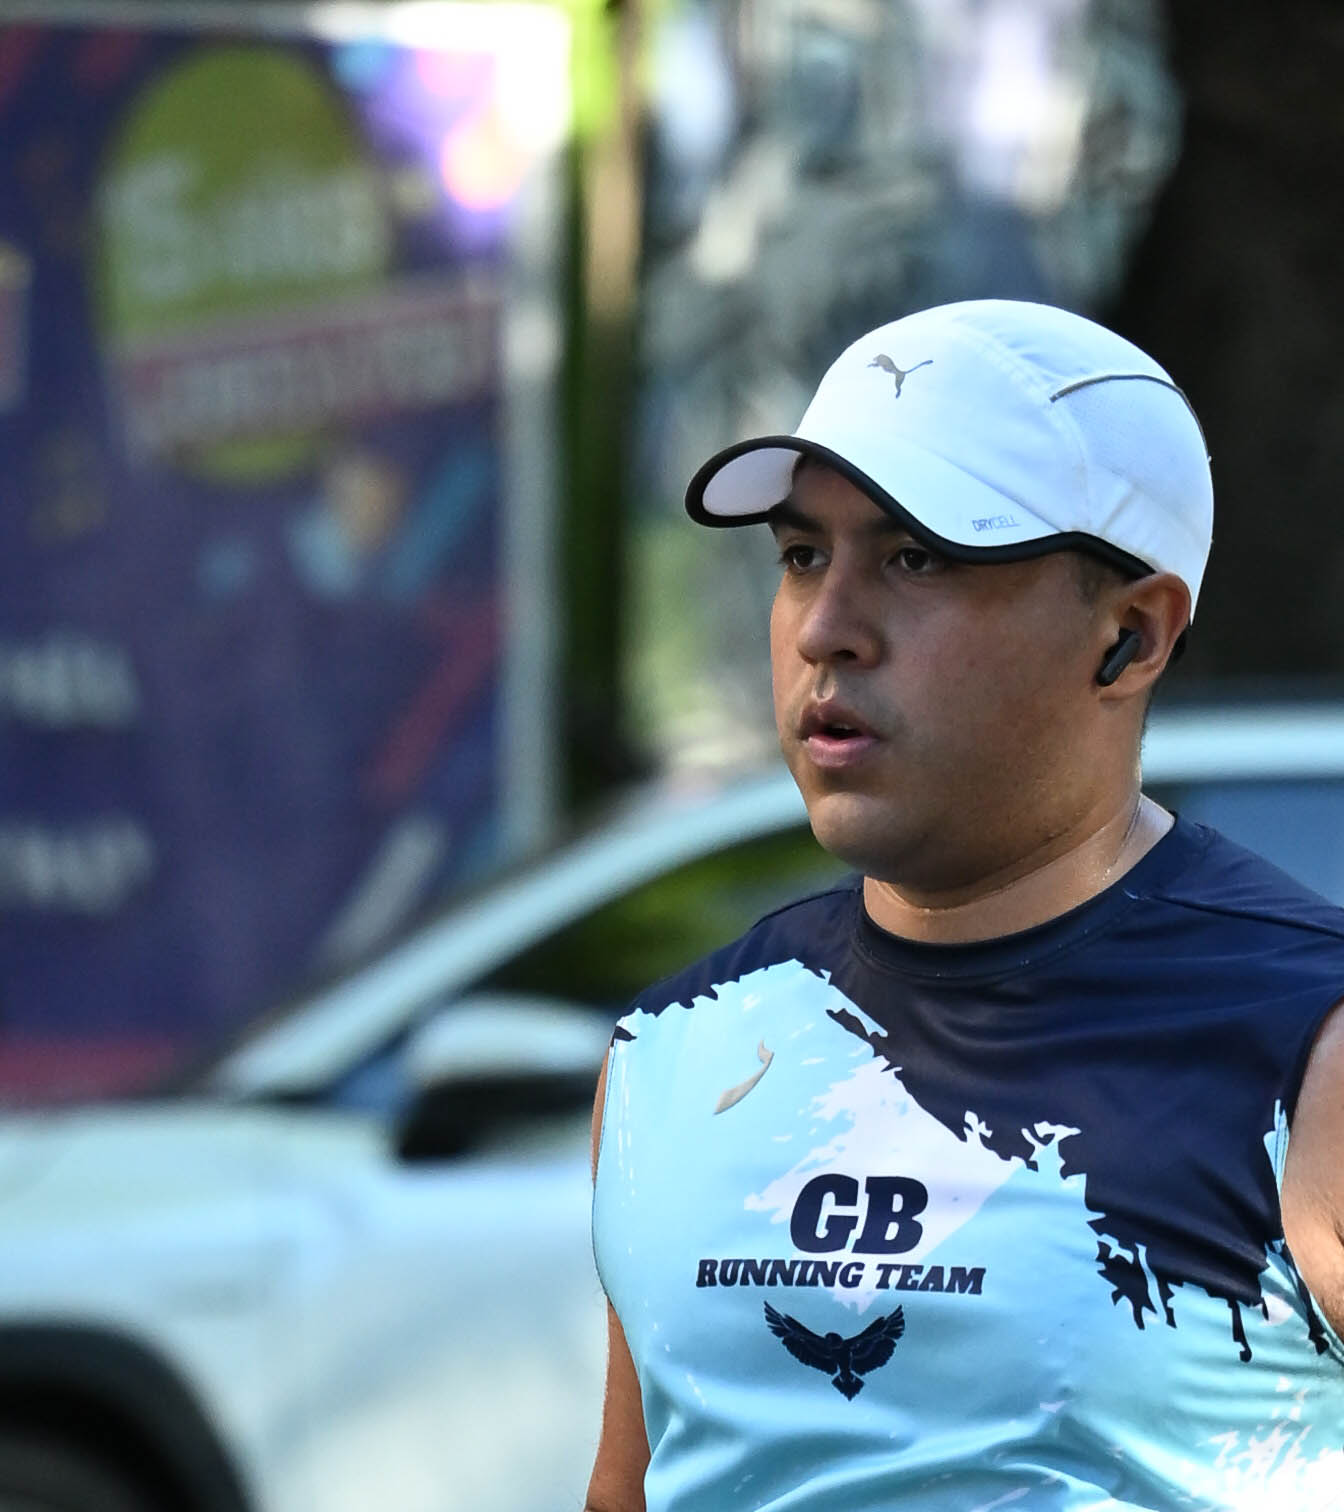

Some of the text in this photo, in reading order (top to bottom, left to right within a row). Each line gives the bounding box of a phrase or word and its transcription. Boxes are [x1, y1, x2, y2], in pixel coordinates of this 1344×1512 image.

[790, 1173, 929, 1255] GB
[696, 1258, 987, 1296] RUNNING TEAM
